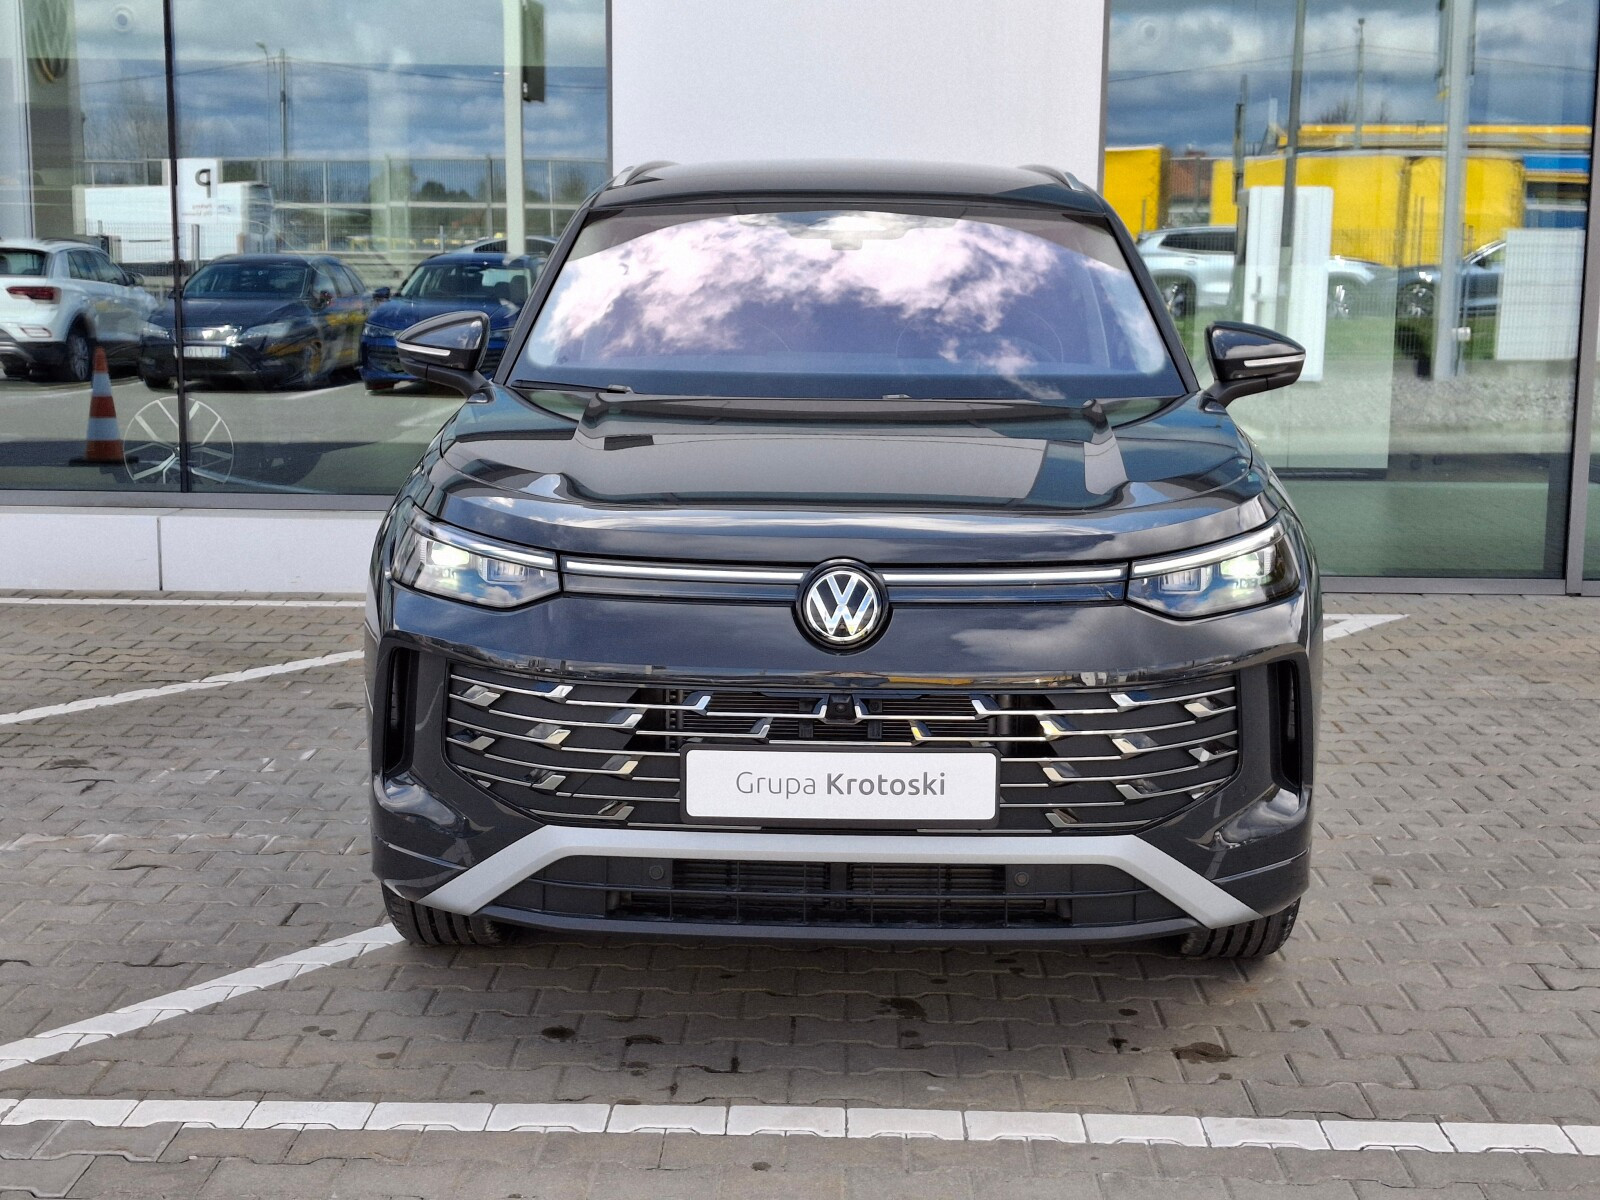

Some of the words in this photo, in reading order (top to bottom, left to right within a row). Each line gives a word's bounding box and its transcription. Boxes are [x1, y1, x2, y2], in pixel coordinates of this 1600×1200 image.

[807, 571, 877, 641] VW
[736, 771, 816, 799] Grupa
[826, 772, 945, 796] Krotoski
